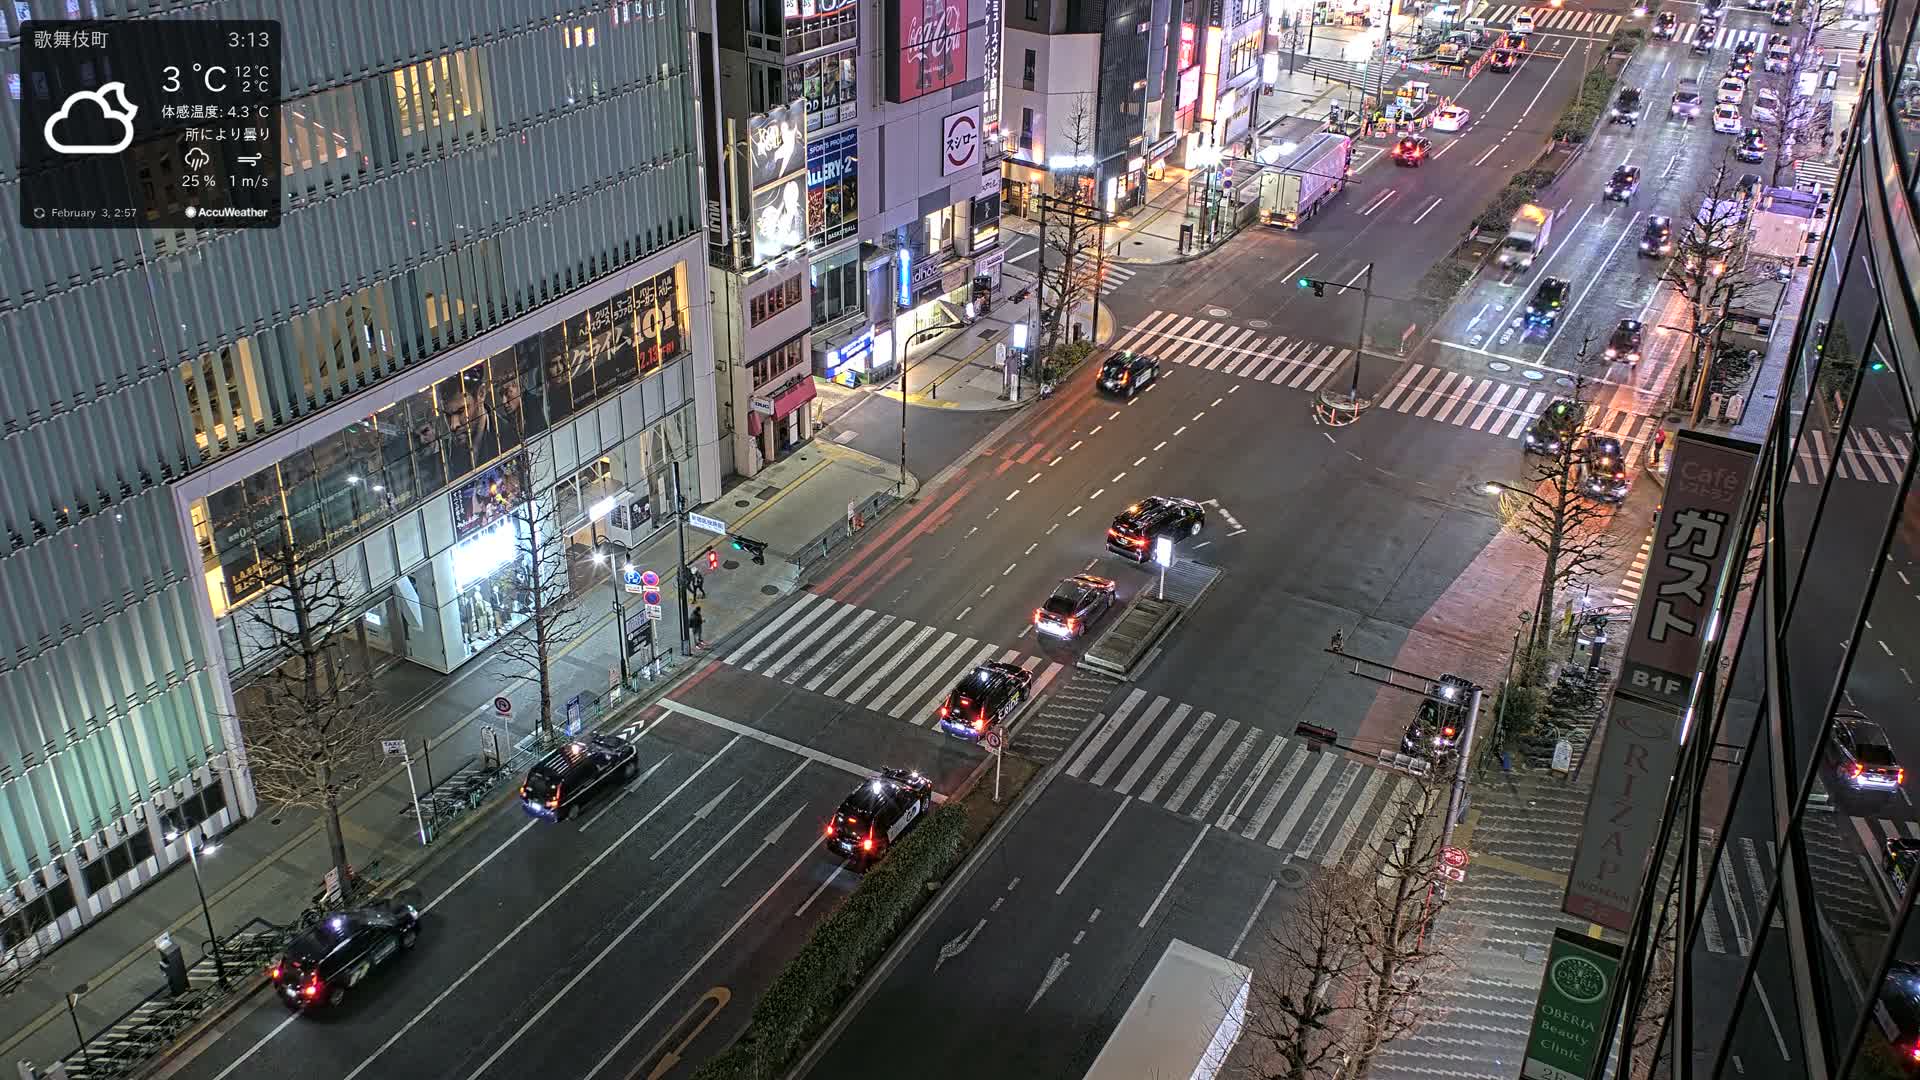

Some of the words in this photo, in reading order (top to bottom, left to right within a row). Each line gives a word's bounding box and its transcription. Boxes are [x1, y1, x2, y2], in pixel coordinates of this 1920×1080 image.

[946, 133, 977, 153] スシロー
[709, 200, 720, 233] MUJI
[1648, 507, 1727, 643] ガスト
[1631, 670, 1681, 695] B1F
[1599, 743, 1649, 881] RIZAP
[1541, 1004, 1595, 1032] OBERIA
[1541, 1020, 1588, 1046] Beauty
[1540, 1039, 1584, 1062] Clinic
